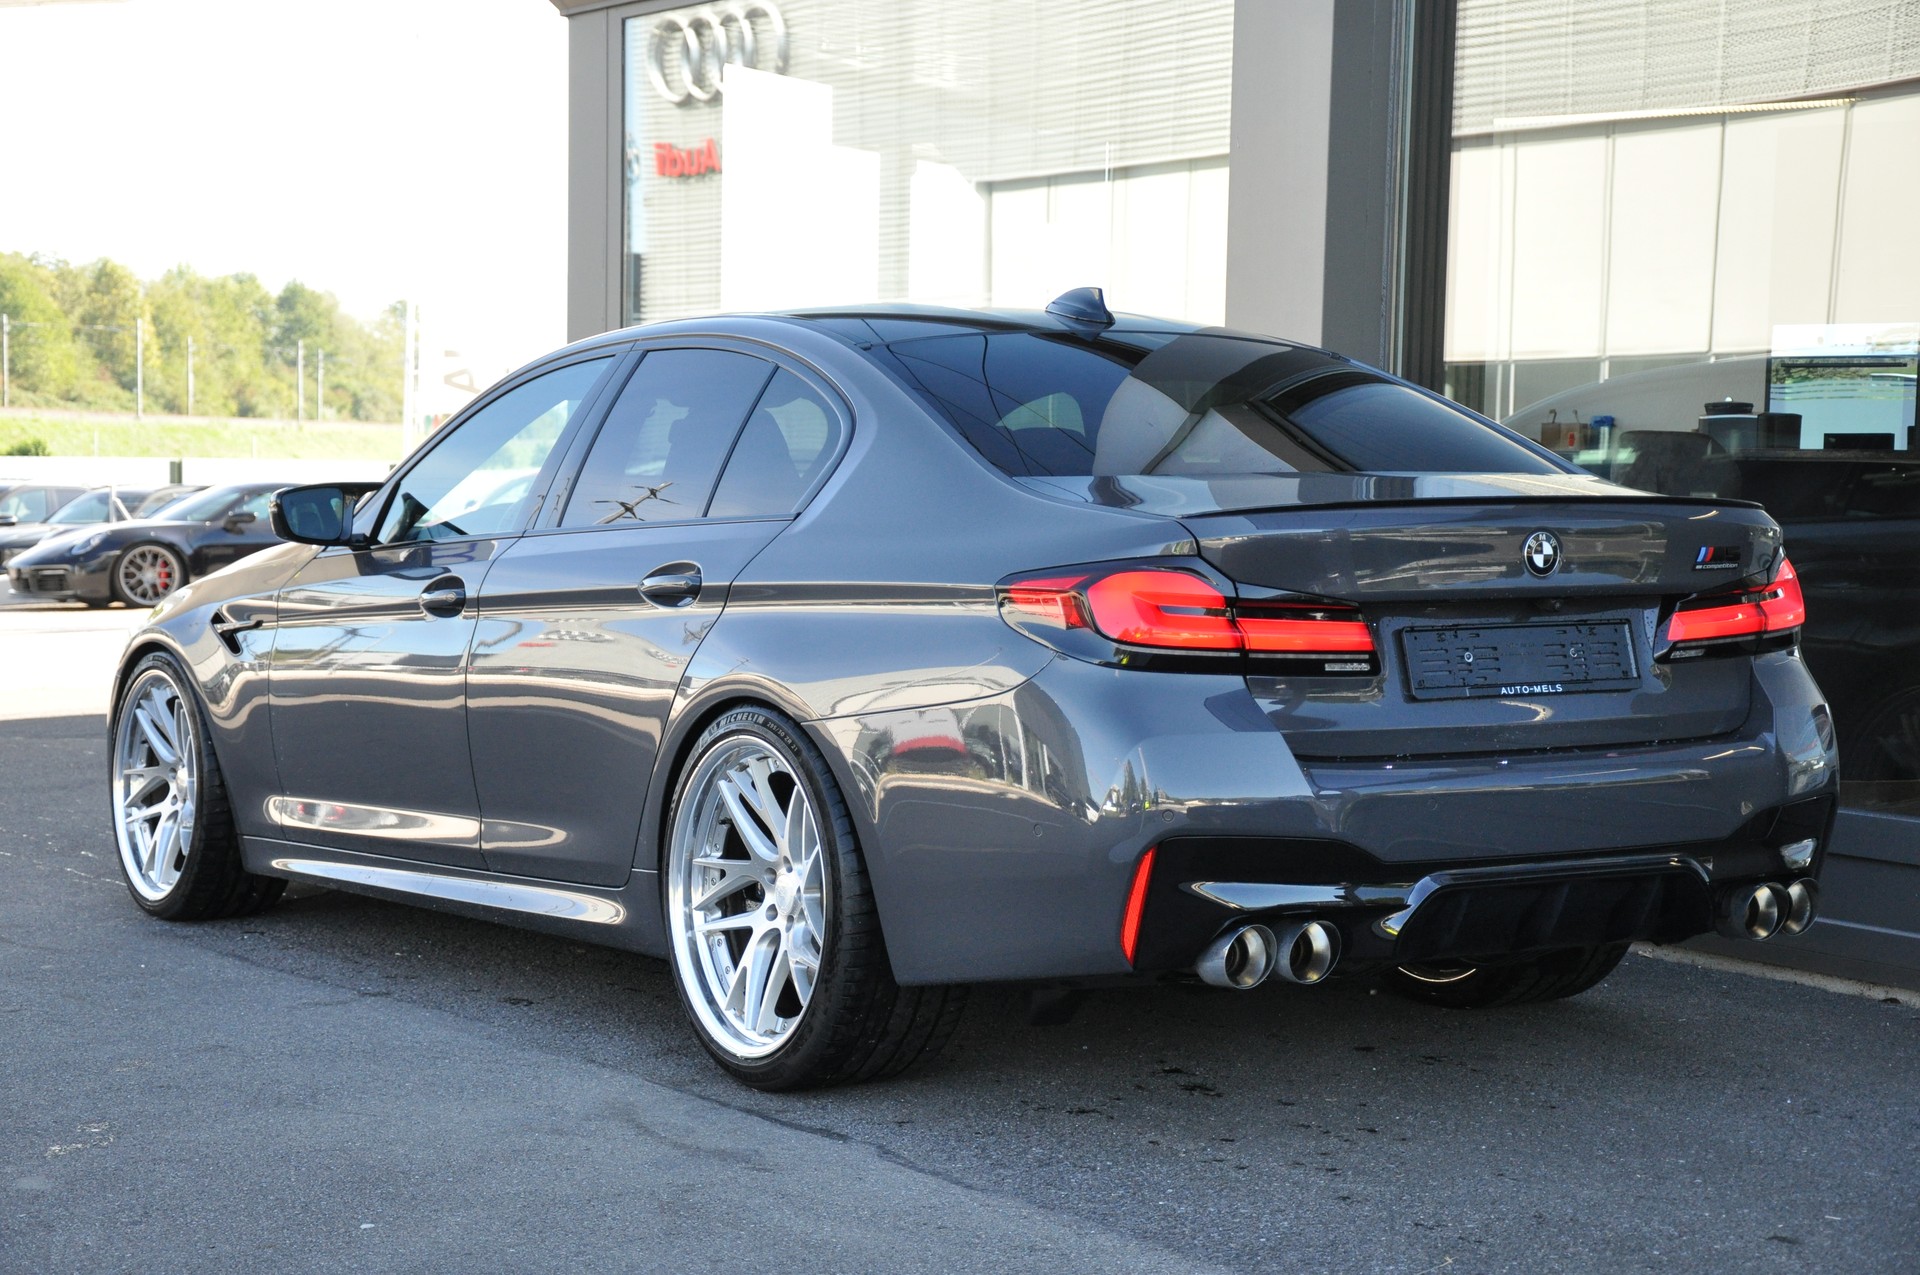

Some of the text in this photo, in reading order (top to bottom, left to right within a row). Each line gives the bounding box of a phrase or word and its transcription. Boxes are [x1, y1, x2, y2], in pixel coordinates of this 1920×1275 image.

[1529, 534, 1557, 547] BMW
[1501, 684, 1563, 695] AUTO-MELS
[720, 713, 765, 725] MICHELIN
